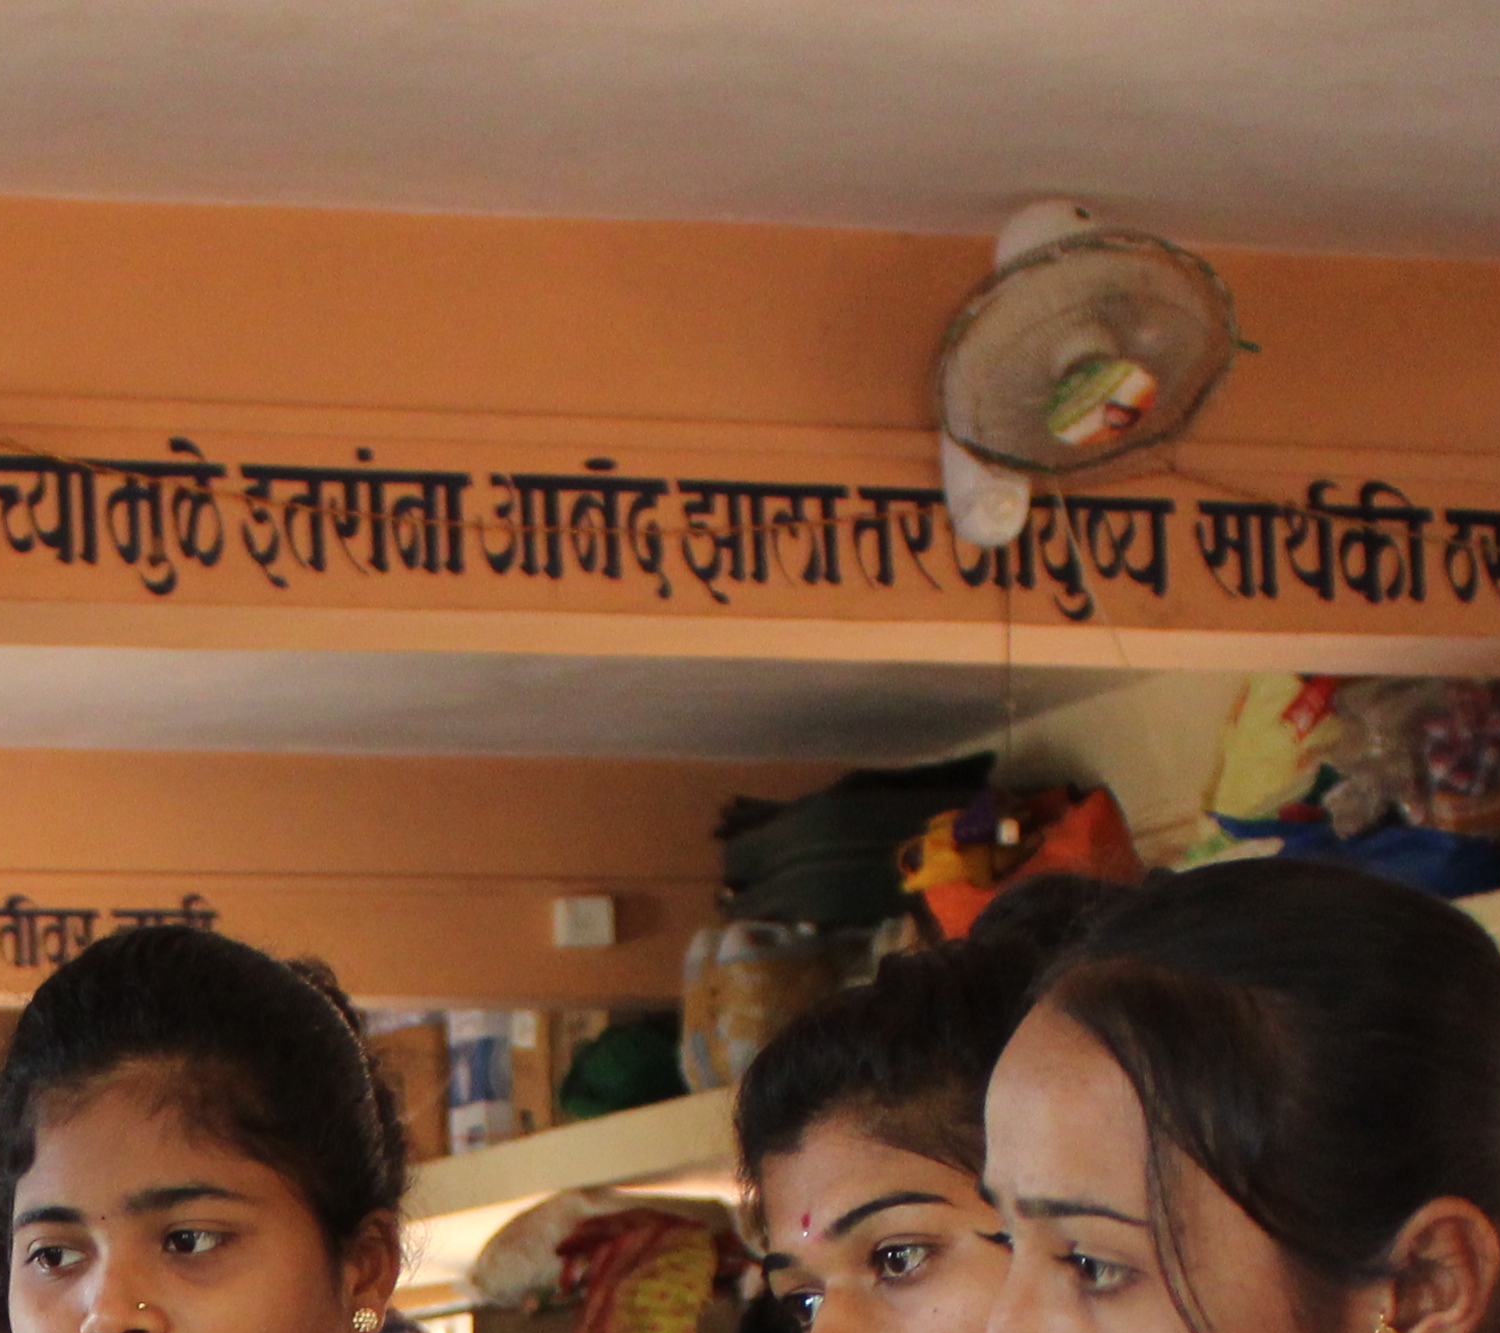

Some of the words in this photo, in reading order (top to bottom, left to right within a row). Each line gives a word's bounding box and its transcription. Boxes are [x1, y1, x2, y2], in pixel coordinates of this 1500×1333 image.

[240, 449, 472, 587] इतरांना
[485, 459, 670, 599] आनंद
[677, 480, 849, 604] झाला
[856, 487, 952, 586] तर
[1195, 480, 1432, 604] सार्थकी
